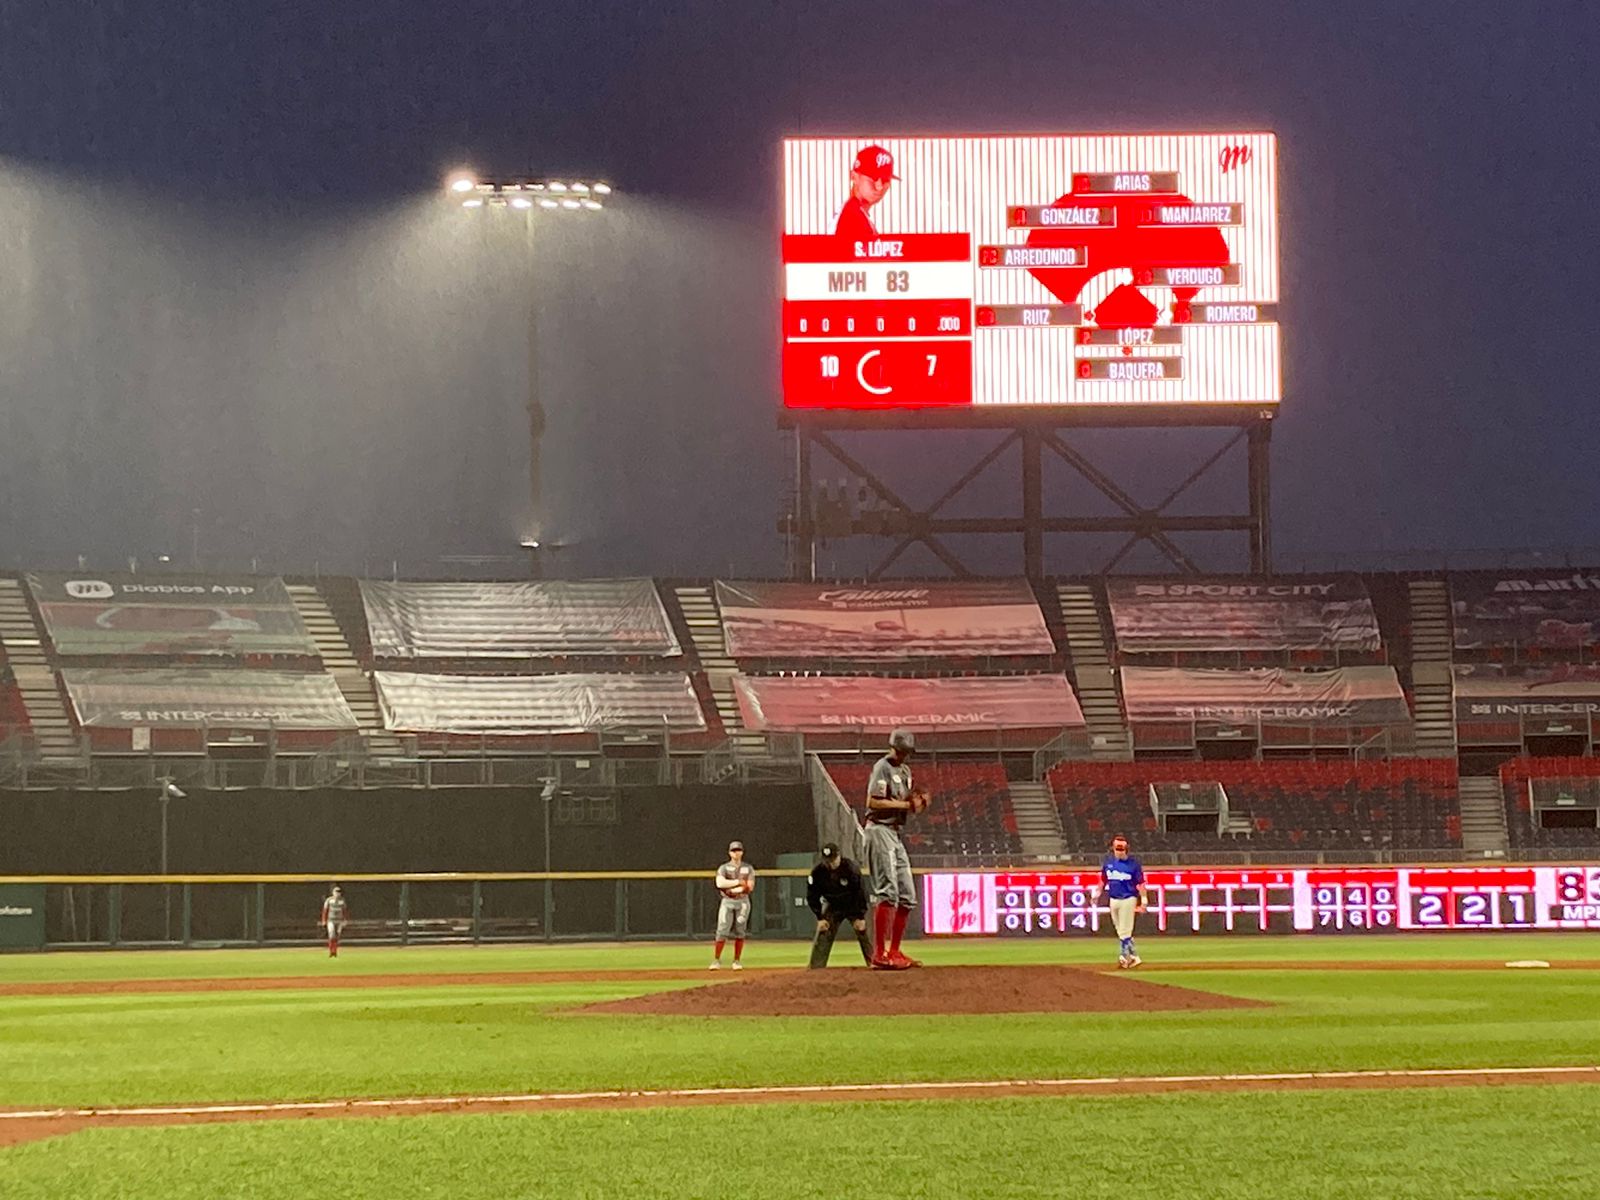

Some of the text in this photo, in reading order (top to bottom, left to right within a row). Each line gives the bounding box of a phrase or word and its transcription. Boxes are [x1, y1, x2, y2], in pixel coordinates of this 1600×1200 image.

[1113, 174, 1150, 191] ARIAS
[1041, 206, 1099, 225] GONZÁLEZ
[1161, 206, 1232, 223] MANJARREZ
[854, 239, 904, 257] S. LÓPEZ
[1005, 248, 1076, 265] ARREDONDO
[828, 270, 910, 292] MPH 83
[1167, 268, 1223, 285] VERDUGO
[1023, 309, 1050, 325] RUIZ
[1206, 305, 1258, 322] ROMERO
[1118, 327, 1154, 344] LÓPEZ
[820, 355, 839, 377] 10
[926, 354, 938, 376] 7
[1109, 362, 1164, 380] BAQUERA
[211, 584, 254, 595] App
[1168, 583, 1335, 596] SPORT CITY
[146, 710, 302, 721] INTERCERAMIC
[845, 712, 998, 725] INTERCERAMIC
[1005, 888, 1391, 907] 0 0 0 0 4 0
[1419, 894, 1525, 922] 2 2 1
[1005, 910, 1391, 929] 0 3 4 7 6 0
